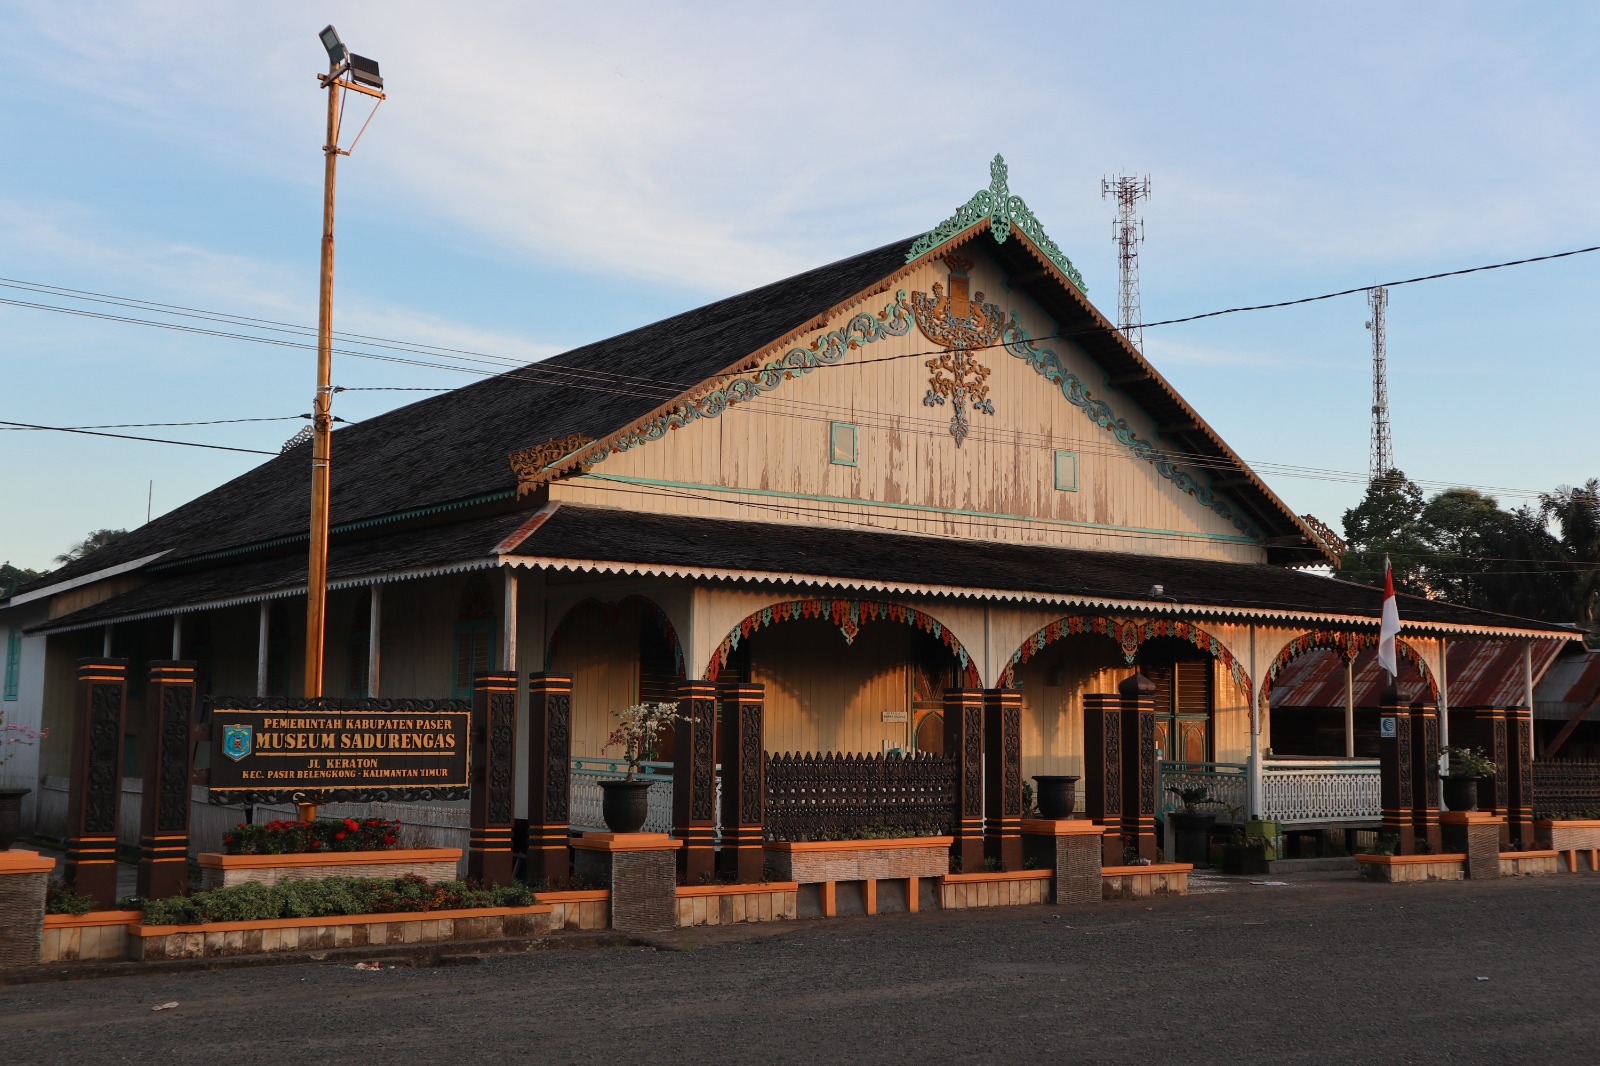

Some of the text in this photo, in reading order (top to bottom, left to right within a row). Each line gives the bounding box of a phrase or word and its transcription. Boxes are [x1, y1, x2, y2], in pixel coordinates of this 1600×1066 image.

[263, 718, 452, 730] PEMERINTAH KABUPATEN PASER
[255, 732, 456, 749] MUSEUM SADURENGAS
[307, 758, 378, 769] JL KERATON
[242, 770, 265, 779] KEC.
[267, 770, 295, 779] PASIR
[297, 769, 356, 779] BELENGKONG
[363, 769, 418, 778] KALIMANTAN
[420, 768, 449, 777] TIMUR
